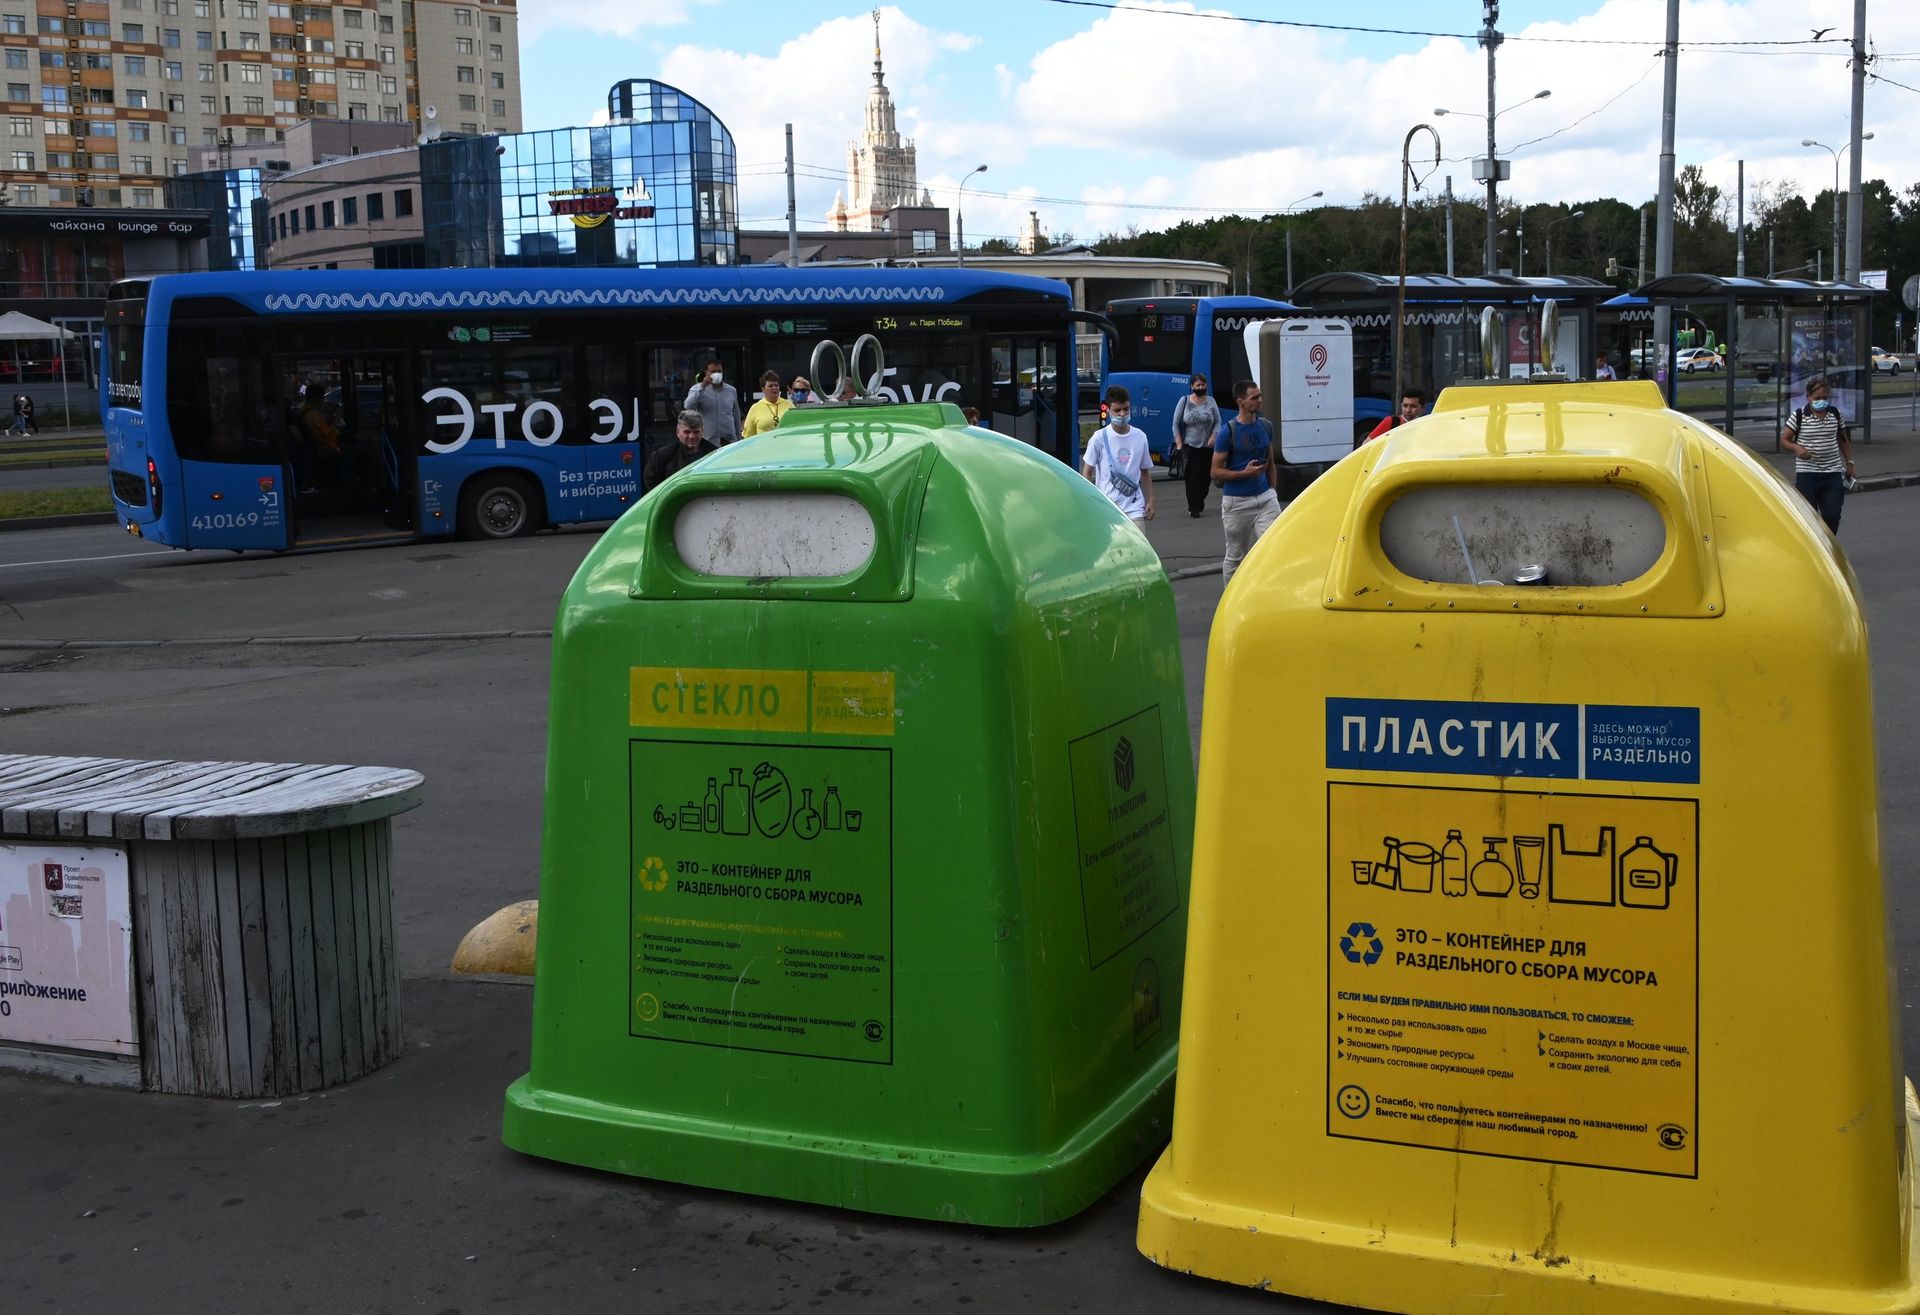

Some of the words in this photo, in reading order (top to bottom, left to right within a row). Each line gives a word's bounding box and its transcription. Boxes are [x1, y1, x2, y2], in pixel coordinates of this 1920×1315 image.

[50, 220, 105, 231] чайхана
[118, 222, 158, 233] lounge
[168, 221, 192, 233] бар
[920, 319, 936, 327] Парк
[938, 318, 963, 327] Победы
[420, 387, 563, 453] Это
[560, 470, 584, 483] Без
[587, 469, 632, 482] тряски
[560, 489, 568, 498] и
[572, 480, 637, 498] вибраций
[192, 512, 258, 529] 410169
[652, 681, 781, 717] СТЕКЛО
[1342, 715, 1561, 760] ПЛАСТИК
[1592, 723, 1624, 734] ЗДЕСЬ
[1627, 724, 1666, 735] МОЖНО
[1592, 735, 1653, 746] ВЫБРОСИТЬ
[1656, 737, 1691, 747] МУСОР
[1592, 747, 1692, 765] РАЗДЕЛЬНО
[677, 861, 699, 874] ЭТО
[711, 863, 782, 880] КОНТЕЙНЕР
[785, 868, 811, 884] ДЛЯ
[677, 880, 762, 899] РАЗДЕЛЬНОГО
[764, 887, 806, 903] СБОРА
[809, 890, 863, 906] МУСОРА
[643, 933, 673, 941] Несколько
[1396, 927, 1428, 945] ЭТО
[1446, 931, 1546, 956] КОНТЕЙНЕР
[1550, 940, 1587, 958] ДЛЯ
[8, 955, 20, 966] Play
[840, 951, 865, 960] Москве
[1396, 951, 1517, 976] РАЗДЕЛЬНОГО
[1521, 961, 1580, 981] СБОРА
[1583, 965, 1659, 987] МУСОРА
[662, 1001, 692, 1012] Спасибо,
[705, 1007, 748, 1018] пользуетесь
[748, 1011, 797, 1022] контейнерами
[799, 1016, 808, 1024] по
[809, 1018, 857, 1028] назначению!
[1337, 991, 1361, 1001] ЕСЛИ
[1362, 994, 1378, 1003] МЫ
[1380, 995, 1410, 1007] БУДЕМ
[1411, 998, 1467, 1012] ПРАВИЛЬНО
[1468, 1002, 1490, 1014] ИМИ
[1492, 1006, 1570, 1021] ПОЛЬЗОВАТЬСЯ,
[1572, 1012, 1585, 1022] ТО
[1586, 1013, 1635, 1026] СМОЖЕМ:
[662, 1011, 686, 1021] Вместе
[749, 1022, 782, 1032] любимый
[1346, 1013, 1390, 1026] Несколько
[1391, 1018, 1406, 1028] раз
[1407, 1020, 1464, 1034] использовать
[1466, 1025, 1487, 1036] одно
[1354, 1026, 1363, 1034] то
[1364, 1027, 1376, 1035] же
[1377, 1028, 1403, 1040] сырье
[1548, 1032, 1585, 1046] Сделать
[1586, 1037, 1617, 1048] воздух
[1626, 1039, 1661, 1051] Москве
[1663, 1043, 1690, 1055] чище,
[1346, 1037, 1390, 1051] Экономить
[1391, 1043, 1438, 1057] природные
[1439, 1048, 1475, 1061] ресурсы
[1548, 1047, 1595, 1060] Сохранить
[1596, 1053, 1640, 1065] экологию
[1641, 1057, 1658, 1066] для
[1659, 1058, 1682, 1068] себя
[1346, 1052, 1385, 1065] Улучшить
[1386, 1058, 1428, 1070] состояние
[1430, 1062, 1485, 1076] окружающей
[1486, 1068, 1514, 1080] среды
[1556, 1062, 1582, 1071] своих
[1583, 1063, 1612, 1074] детей.
[1375, 1094, 1417, 1109] Спасибо,
[1418, 1101, 1434, 1110] что
[1436, 1104, 1495, 1117] пользуетесь
[1496, 1109, 1566, 1125] контейнерами
[1568, 1117, 1581, 1126] по
[1583, 1119, 1648, 1133] назначению!
[1375, 1107, 1408, 1120] Вместе
[1410, 1112, 1425, 1121] мы
[1426, 1113, 1474, 1127] сбережем
[1475, 1121, 1496, 1130] наш
[1497, 1122, 1545, 1135] любимый
[1547, 1127, 1579, 1139] город.
